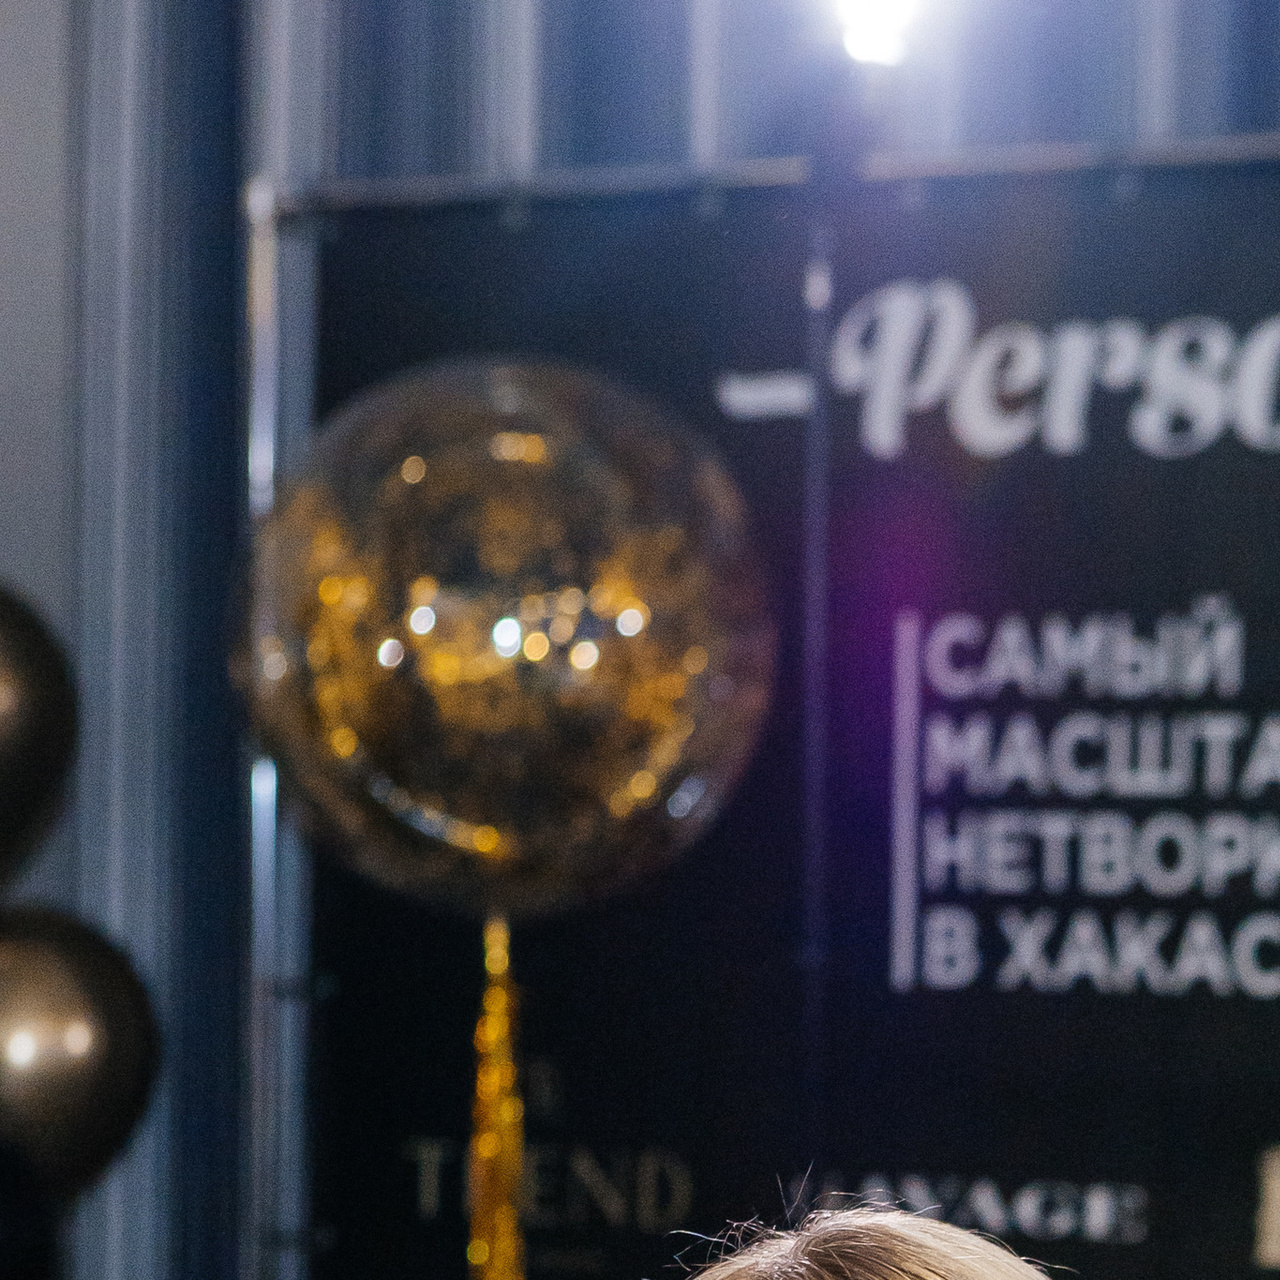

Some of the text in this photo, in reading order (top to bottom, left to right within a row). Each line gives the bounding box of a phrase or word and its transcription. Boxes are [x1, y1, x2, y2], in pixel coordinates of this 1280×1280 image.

[924, 597, 1245, 698] САМЫЙ
[921, 905, 981, 988] В
[403, 1137, 693, 1230] TEND
